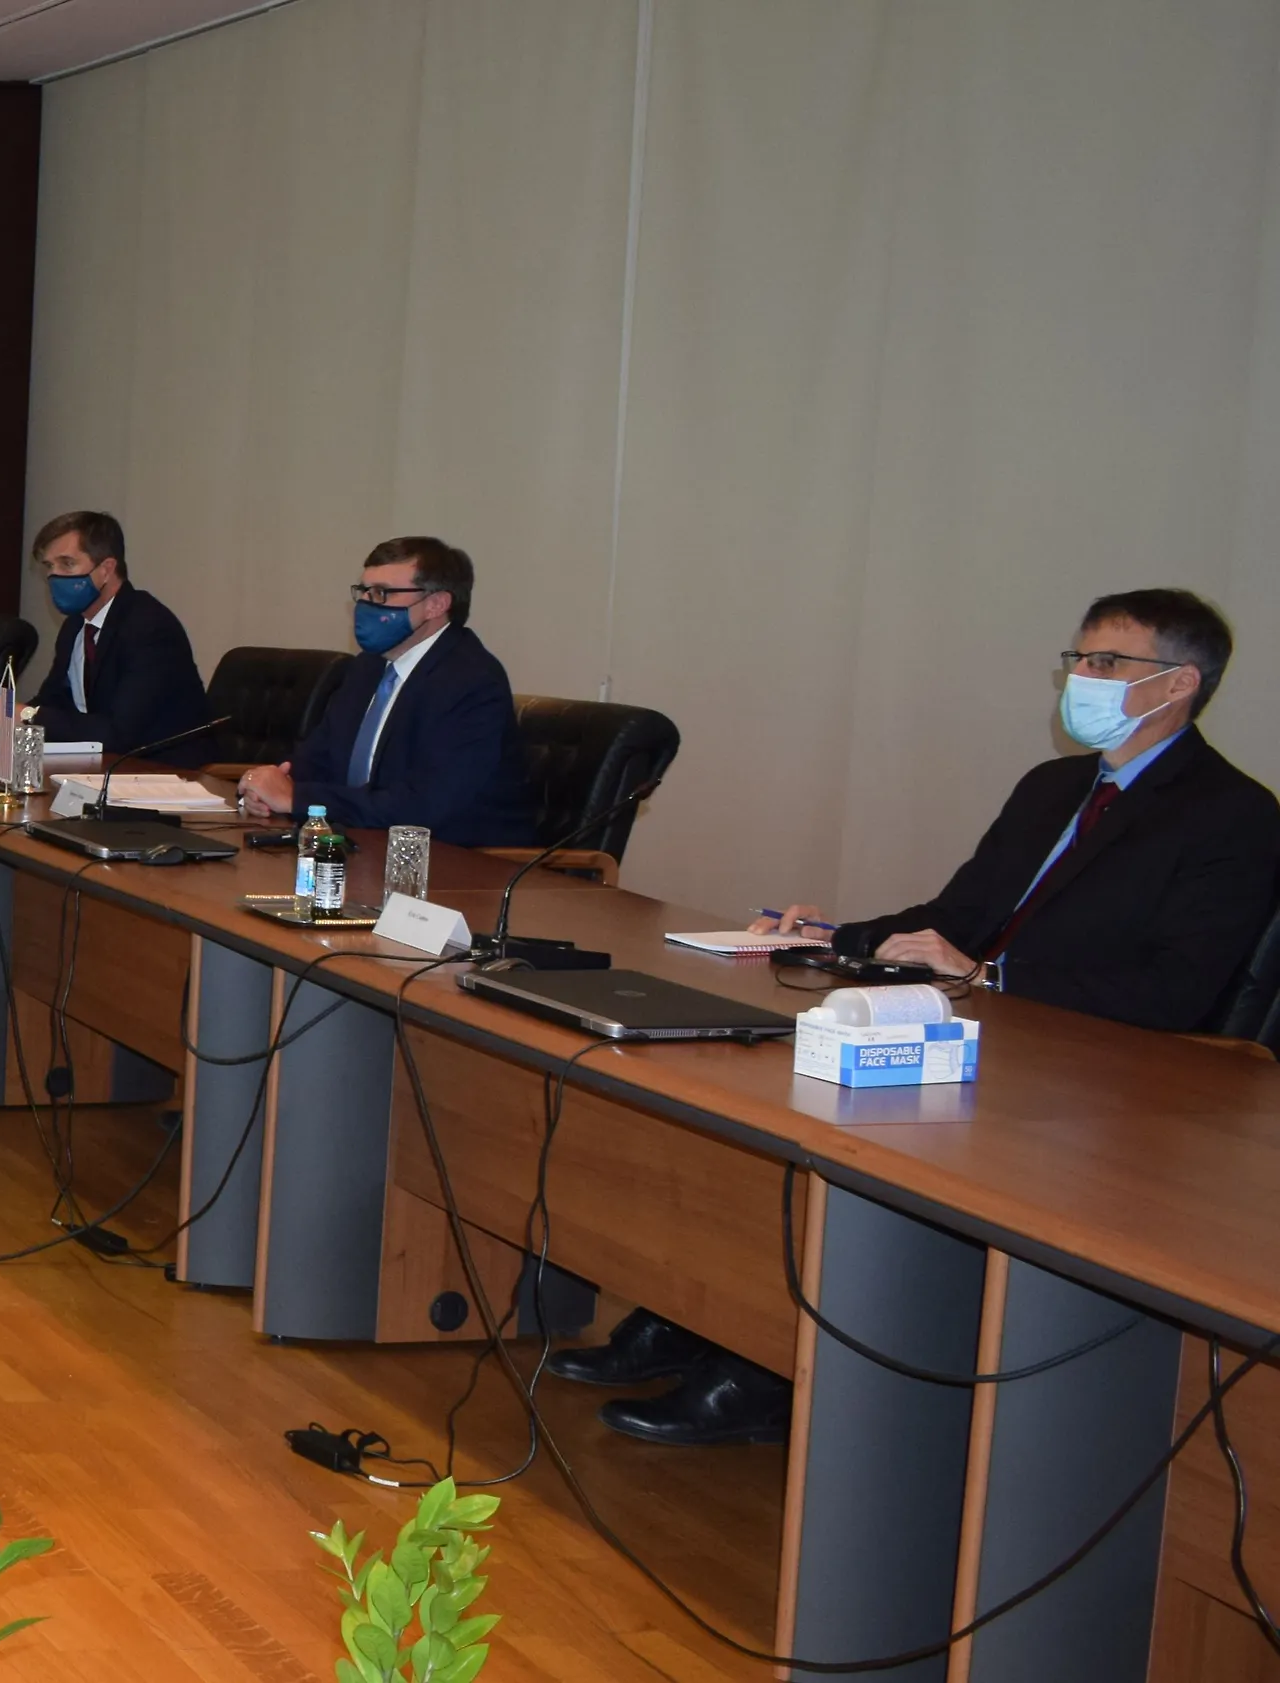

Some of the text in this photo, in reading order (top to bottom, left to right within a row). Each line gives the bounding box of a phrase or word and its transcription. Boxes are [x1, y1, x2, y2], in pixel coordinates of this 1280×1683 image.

[860, 1046, 921, 1057] DISPOSABLE
[859, 1055, 920, 1067] FACE MASK
